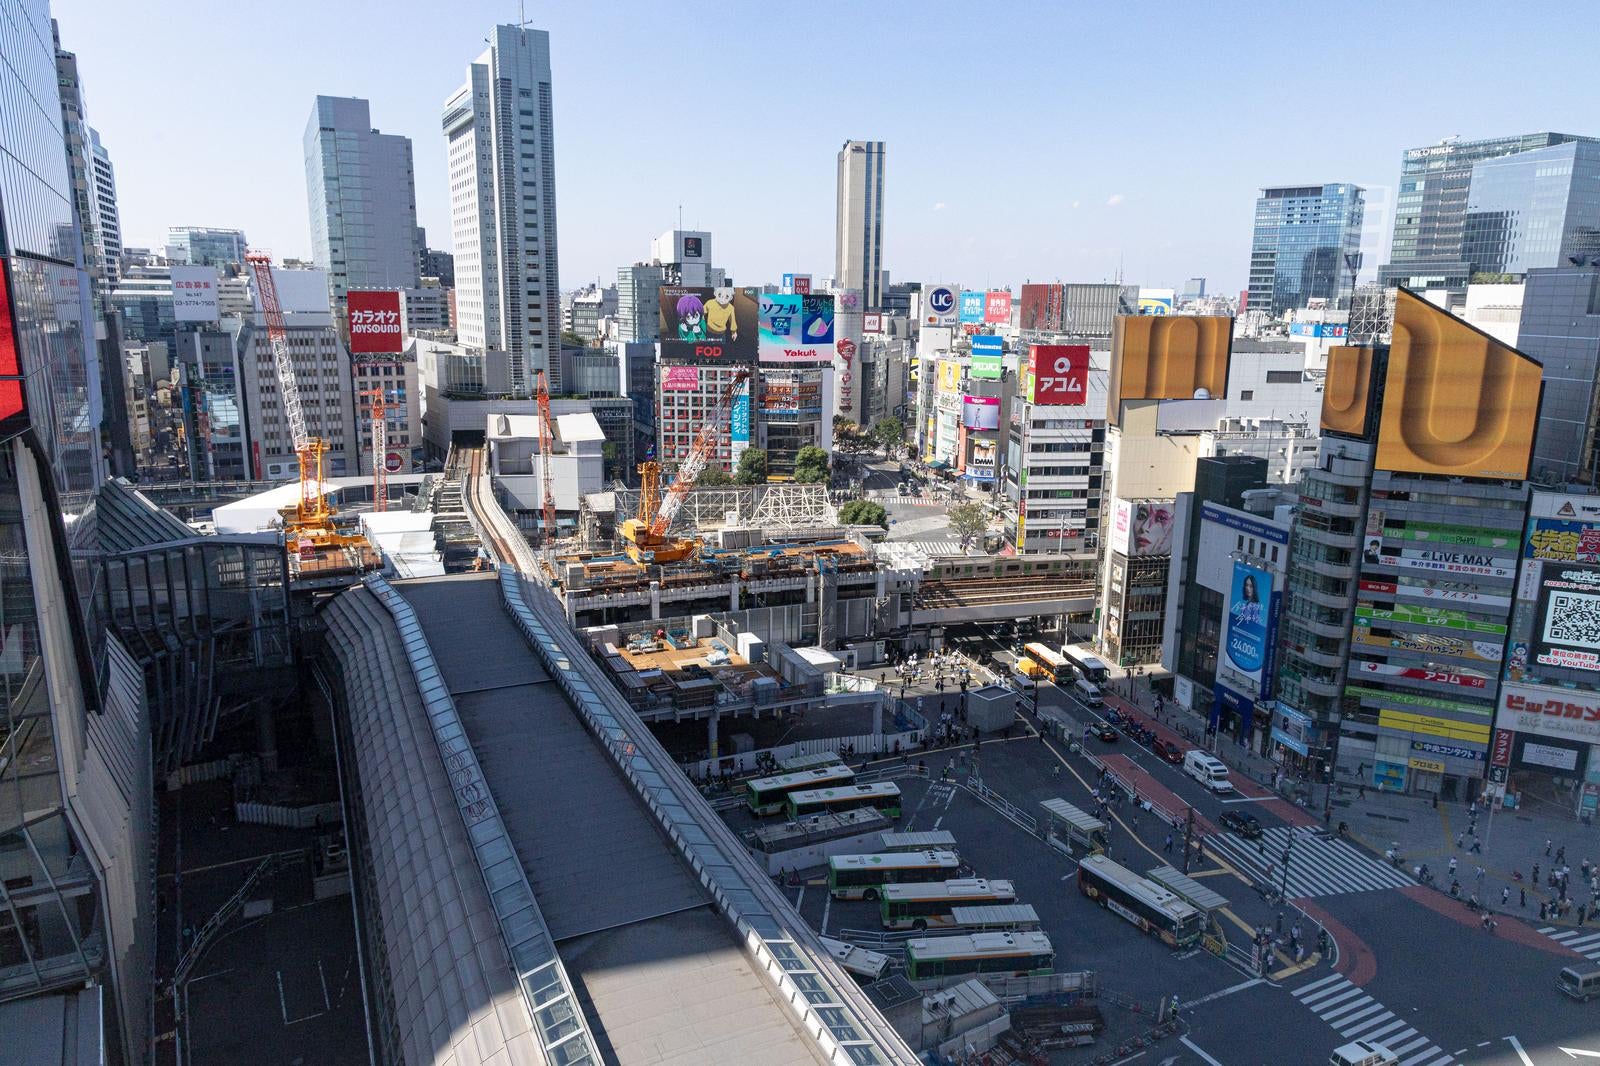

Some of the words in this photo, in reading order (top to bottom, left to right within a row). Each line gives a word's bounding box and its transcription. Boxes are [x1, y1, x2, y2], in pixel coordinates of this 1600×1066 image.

[803, 298, 834, 307] ヤクルトの
[931, 294, 953, 307] UC
[352, 310, 398, 324] カラオケ
[352, 324, 400, 333] JOYSOUND
[696, 346, 722, 357] FOD
[784, 349, 817, 357] Yakult
[1039, 377, 1082, 393] アコム
[1432, 552, 1459, 563] LiVE
[1463, 554, 1493, 567] MAX
[1427, 616, 1447, 625] レイク
[1538, 656, 1560, 665] こちら
[1562, 659, 1600, 669] YouTube
[1424, 671, 1460, 684] アコム
[1424, 743, 1473, 757] 中央コンタクト
[1496, 732, 1509, 761] カラオケ
[1413, 760, 1440, 770] プロミス
